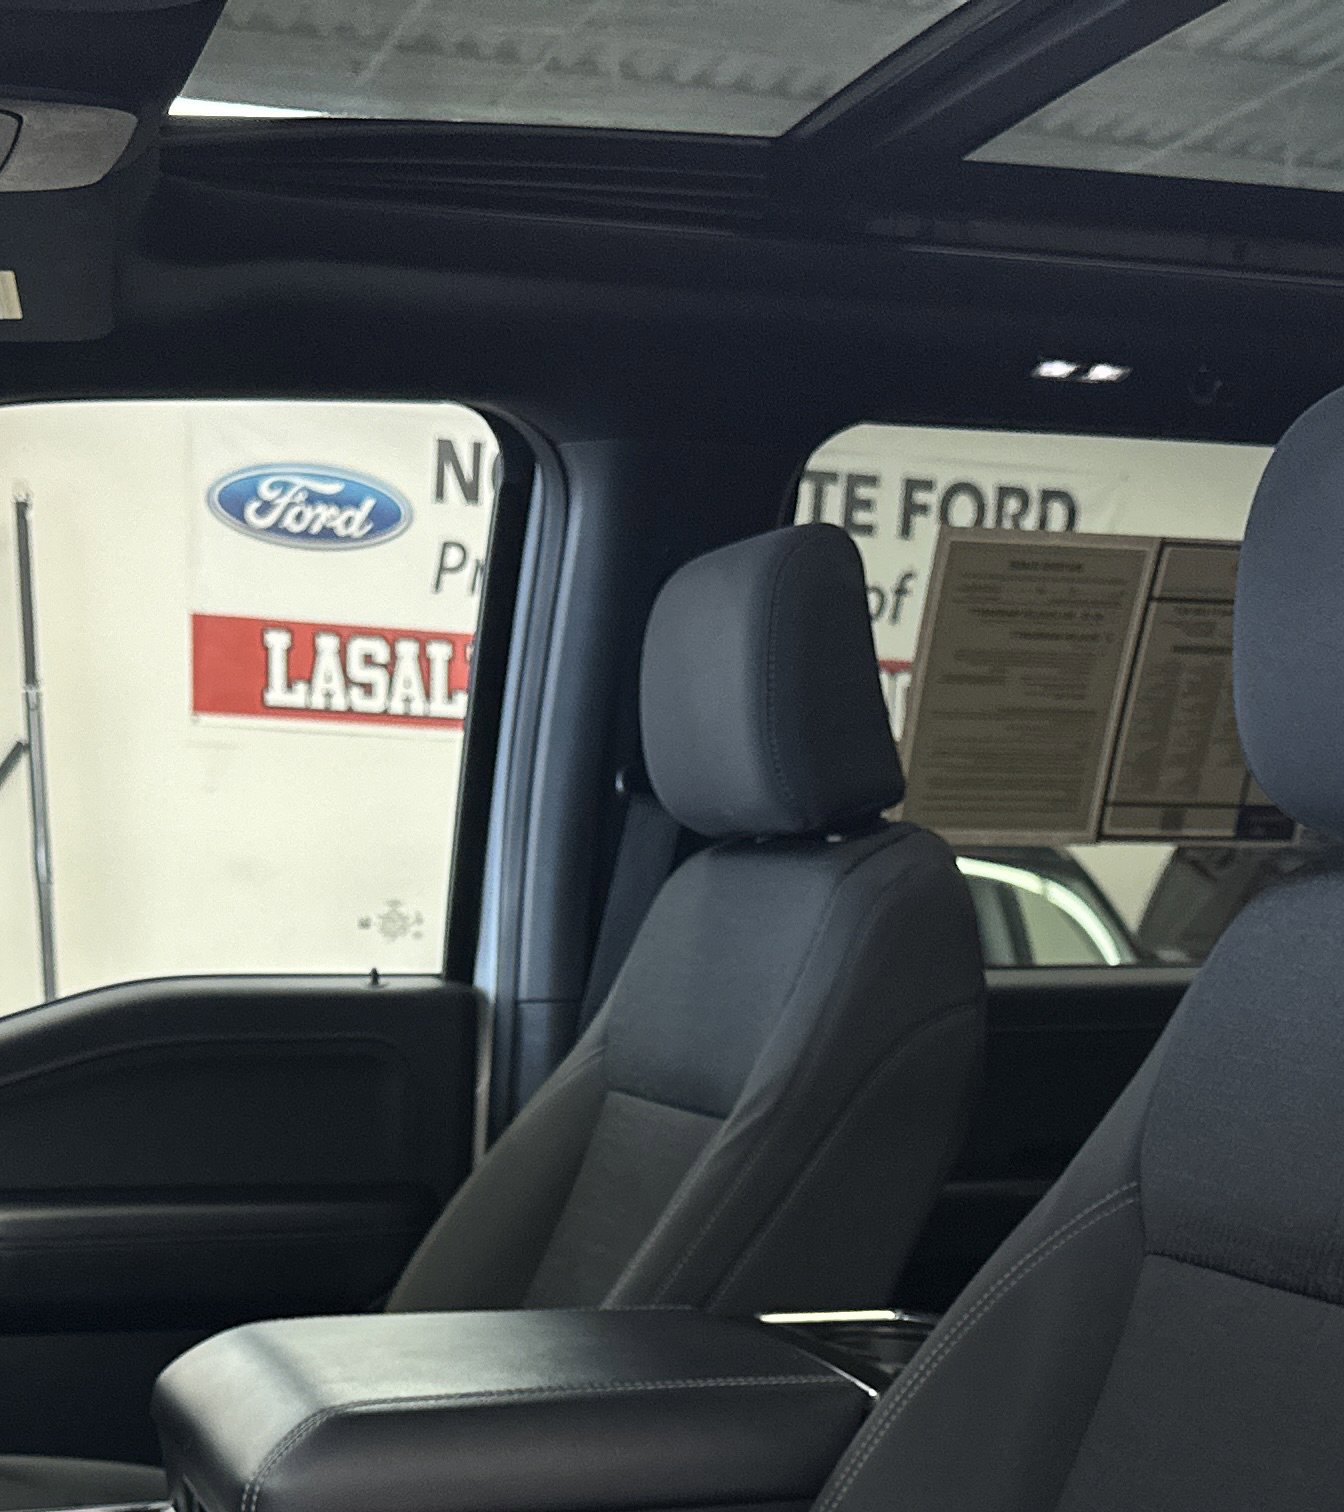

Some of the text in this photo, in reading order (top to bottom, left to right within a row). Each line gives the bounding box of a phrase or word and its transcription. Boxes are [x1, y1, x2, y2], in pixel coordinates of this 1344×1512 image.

[243, 474, 375, 539] Ford
[901, 477, 1077, 540] FORD
[262, 626, 474, 719] LASAL
